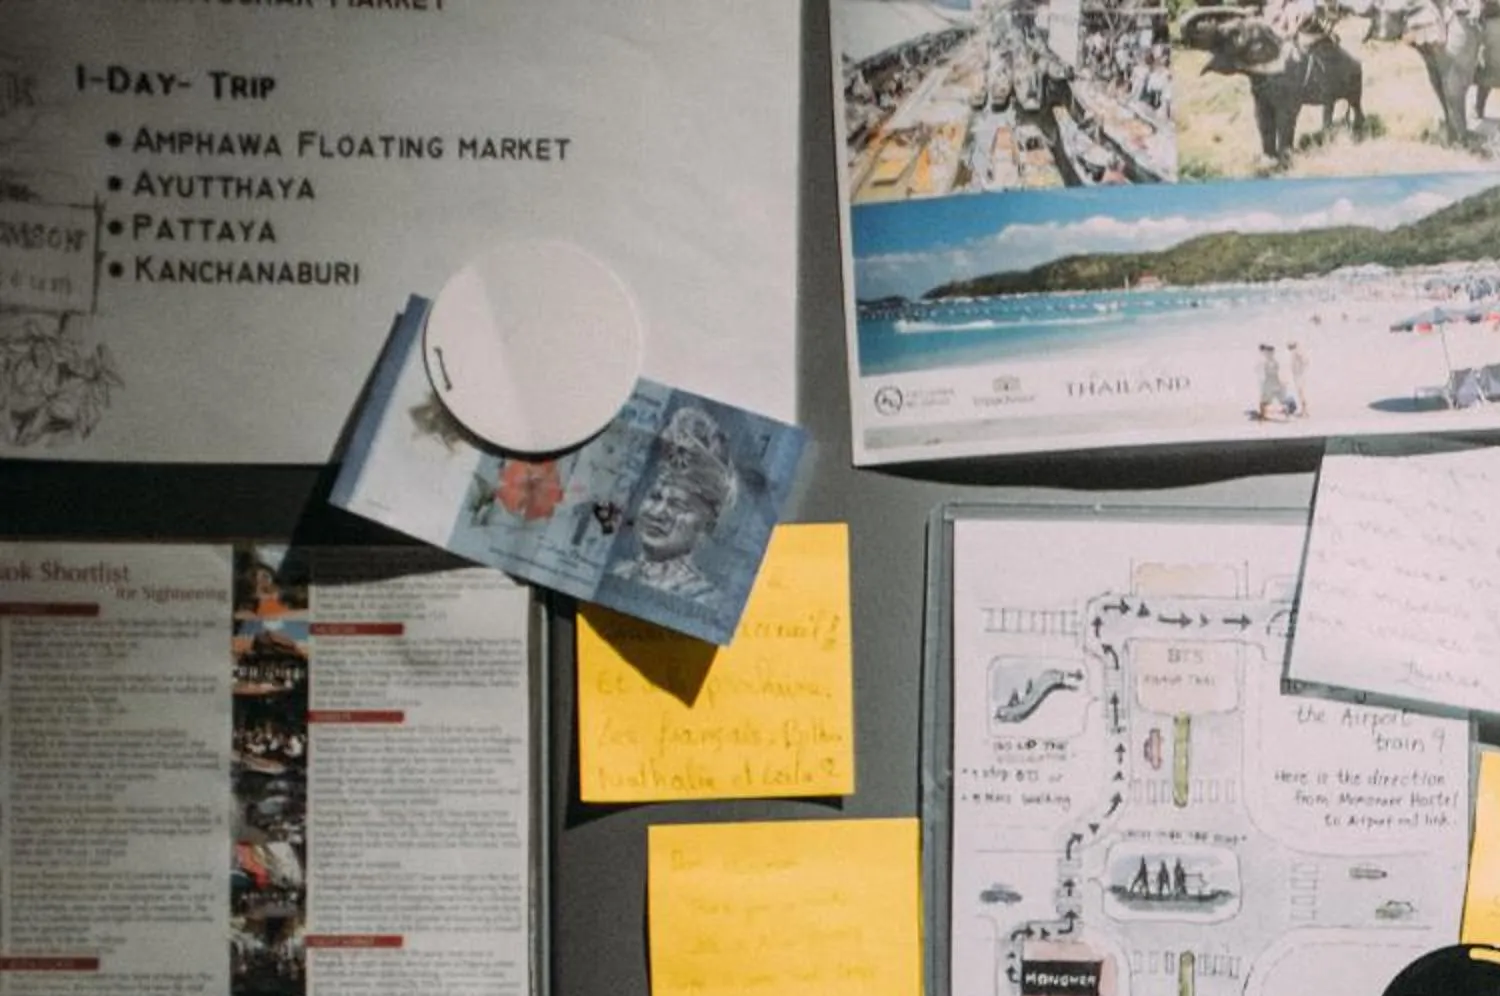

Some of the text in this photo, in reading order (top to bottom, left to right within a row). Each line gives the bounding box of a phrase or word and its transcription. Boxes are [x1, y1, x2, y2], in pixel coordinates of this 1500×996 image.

[208, 71, 276, 100] TRIP
[133, 127, 571, 162] AMPHAWA FLOATING MARKET
[133, 170, 316, 200] AYUTTHAYA
[133, 214, 277, 243] PATTAYA
[134, 259, 361, 287] KANCHANABURI
[1066, 377, 1191, 397] THAILAND
[40, 557, 130, 584] Shortlist
[1296, 704, 1412, 737] the Airport
[1375, 733, 1426, 752] train
[1274, 767, 1308, 786] Here
[1337, 767, 1361, 786] the
[1366, 767, 1446, 787] direction
